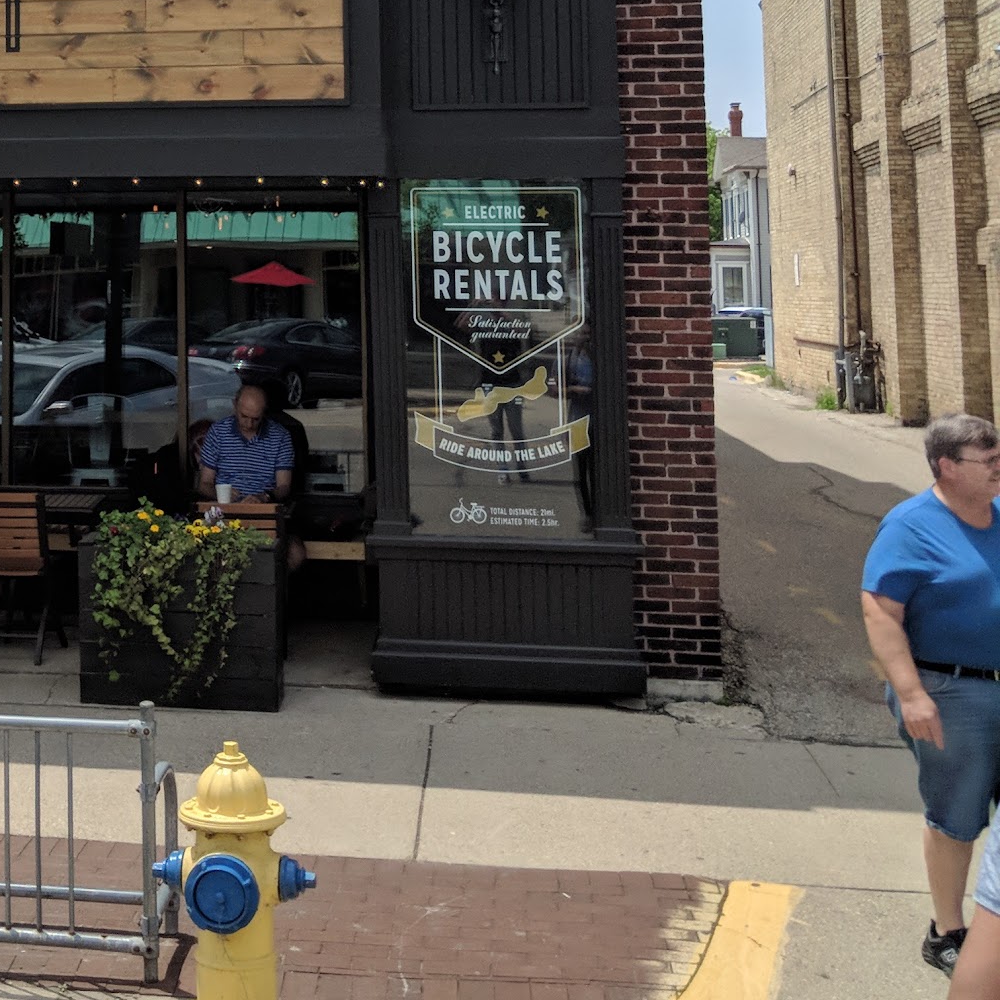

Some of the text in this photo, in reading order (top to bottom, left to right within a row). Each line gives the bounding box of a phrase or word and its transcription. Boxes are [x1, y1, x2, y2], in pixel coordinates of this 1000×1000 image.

[464, 204, 527, 220] ELECTRIC
[432, 230, 562, 264] BICYCLE
[433, 268, 564, 301] RENTALS
[467, 314, 532, 333] Satisfaction
[468, 328, 532, 344] guaranteed
[438, 437, 566, 463] RIDE AROUND THE LAKE
[490, 507, 507, 515] TOTAL
[490, 517, 522, 526] ESTIMATED
